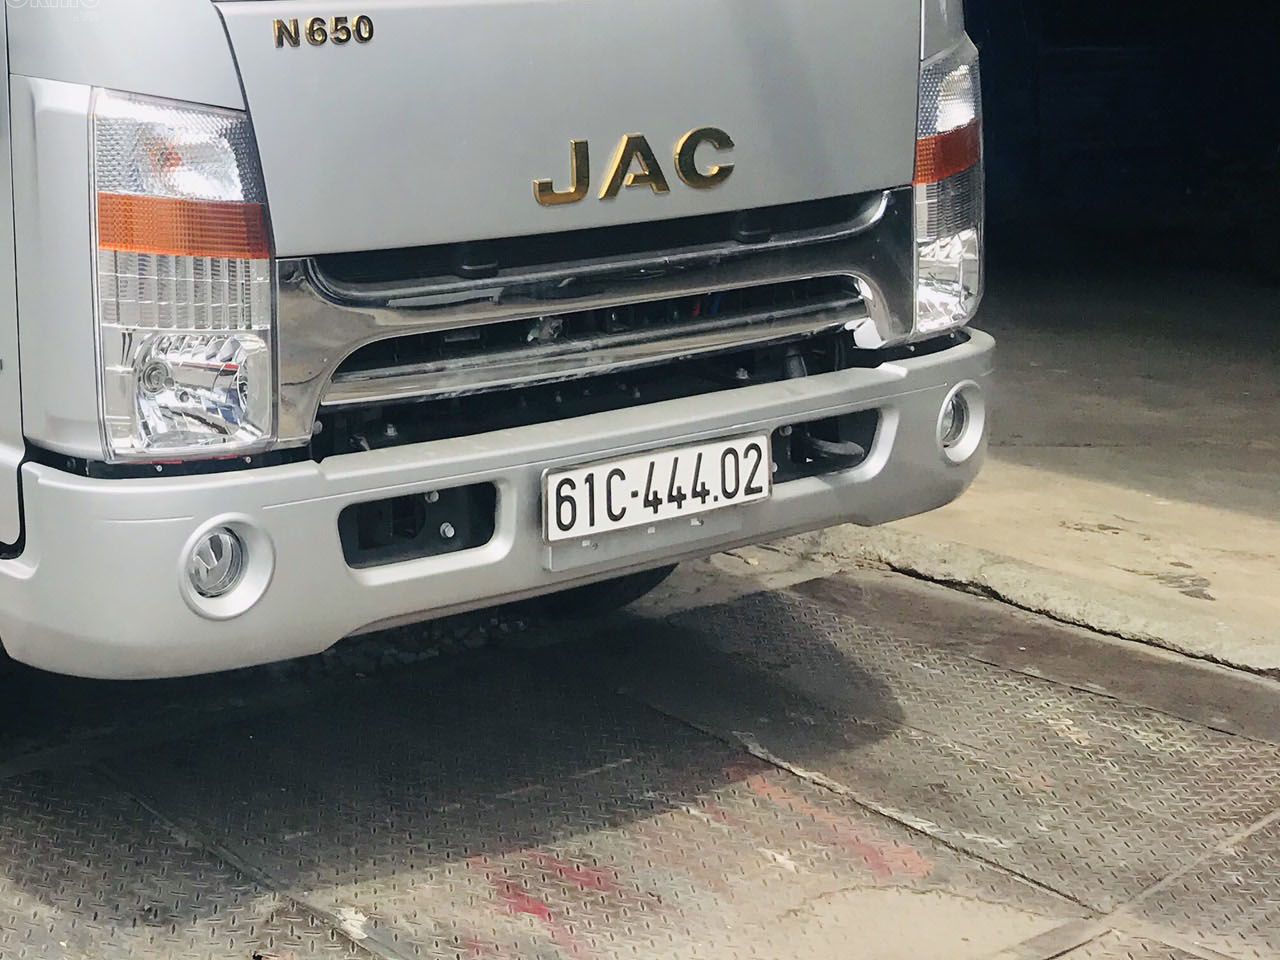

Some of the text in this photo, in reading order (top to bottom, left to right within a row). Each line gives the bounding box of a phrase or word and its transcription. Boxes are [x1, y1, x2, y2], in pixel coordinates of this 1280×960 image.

[273, 14, 374, 48] N650
[533, 126, 736, 206] JAC
[555, 442, 763, 532] 61C-444.02
